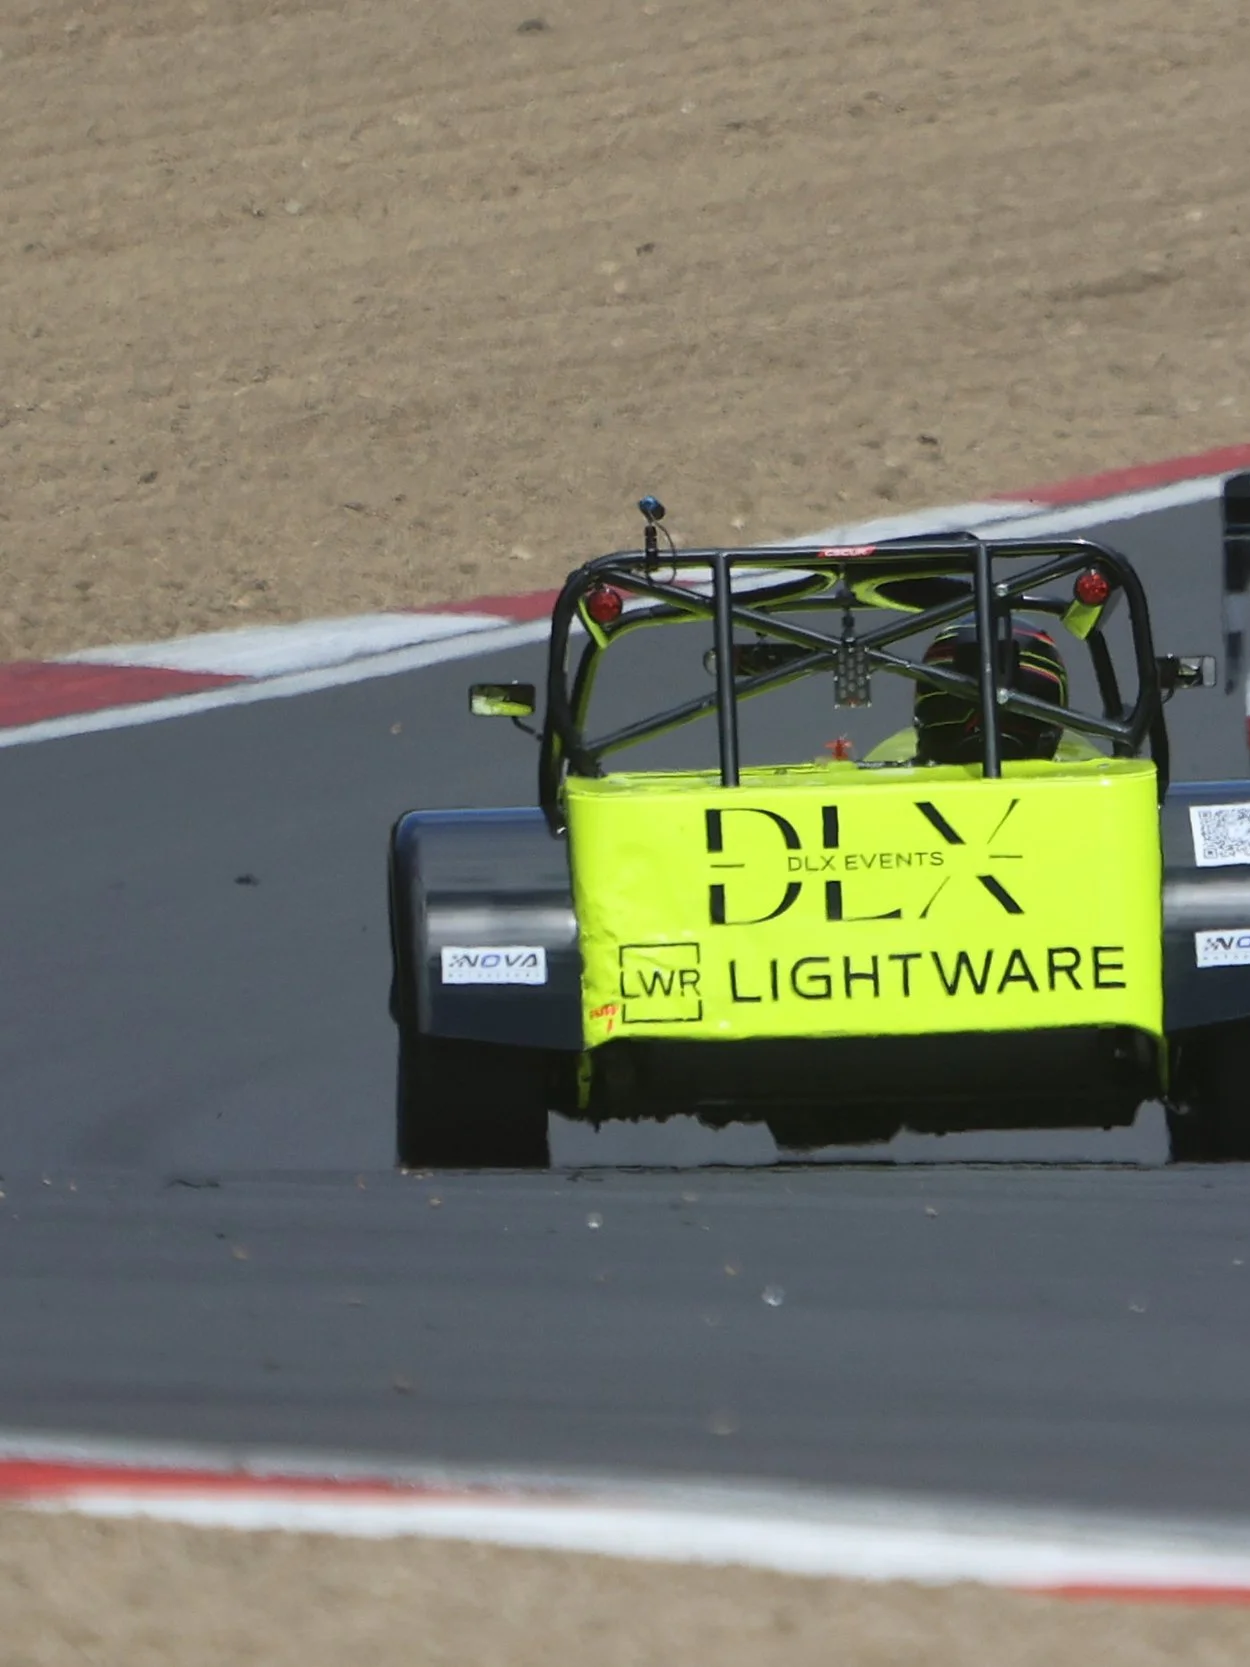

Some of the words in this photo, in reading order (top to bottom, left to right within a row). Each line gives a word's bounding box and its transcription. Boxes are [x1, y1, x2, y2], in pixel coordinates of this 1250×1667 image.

[705, 798, 1025, 926] DLX
[787, 854, 837, 872] DLX
[844, 851, 945, 871] EVENTS
[460, 953, 538, 968] NOVA
[728, 945, 1127, 1004] LIGHTWARE
[620, 969, 701, 999] LWR
